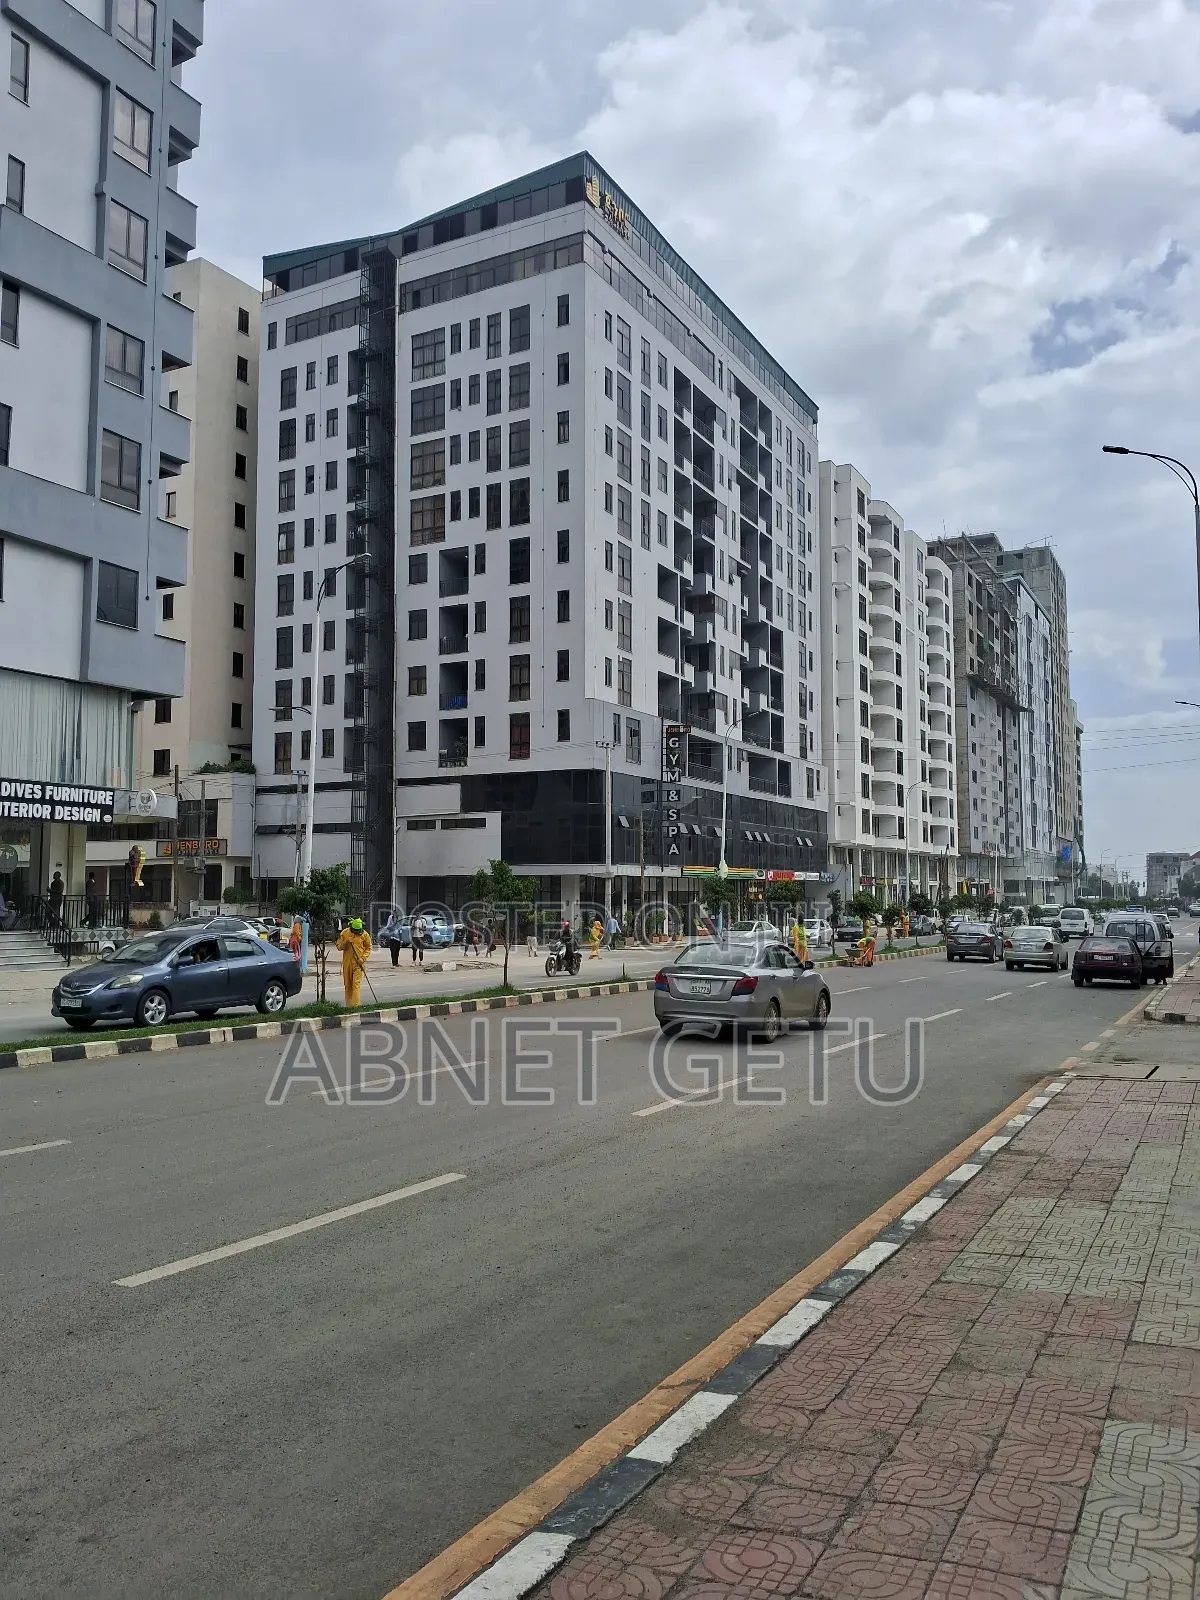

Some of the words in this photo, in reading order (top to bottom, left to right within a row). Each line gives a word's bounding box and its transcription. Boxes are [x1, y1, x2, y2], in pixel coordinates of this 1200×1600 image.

[668, 737, 679, 782] GYM
[1, 781, 42, 799] DIVES
[45, 785, 114, 806] FURNITURE
[668, 790, 679, 802] &
[54, 805, 101, 823] DESIGN
[668, 809, 680, 855] SPA
